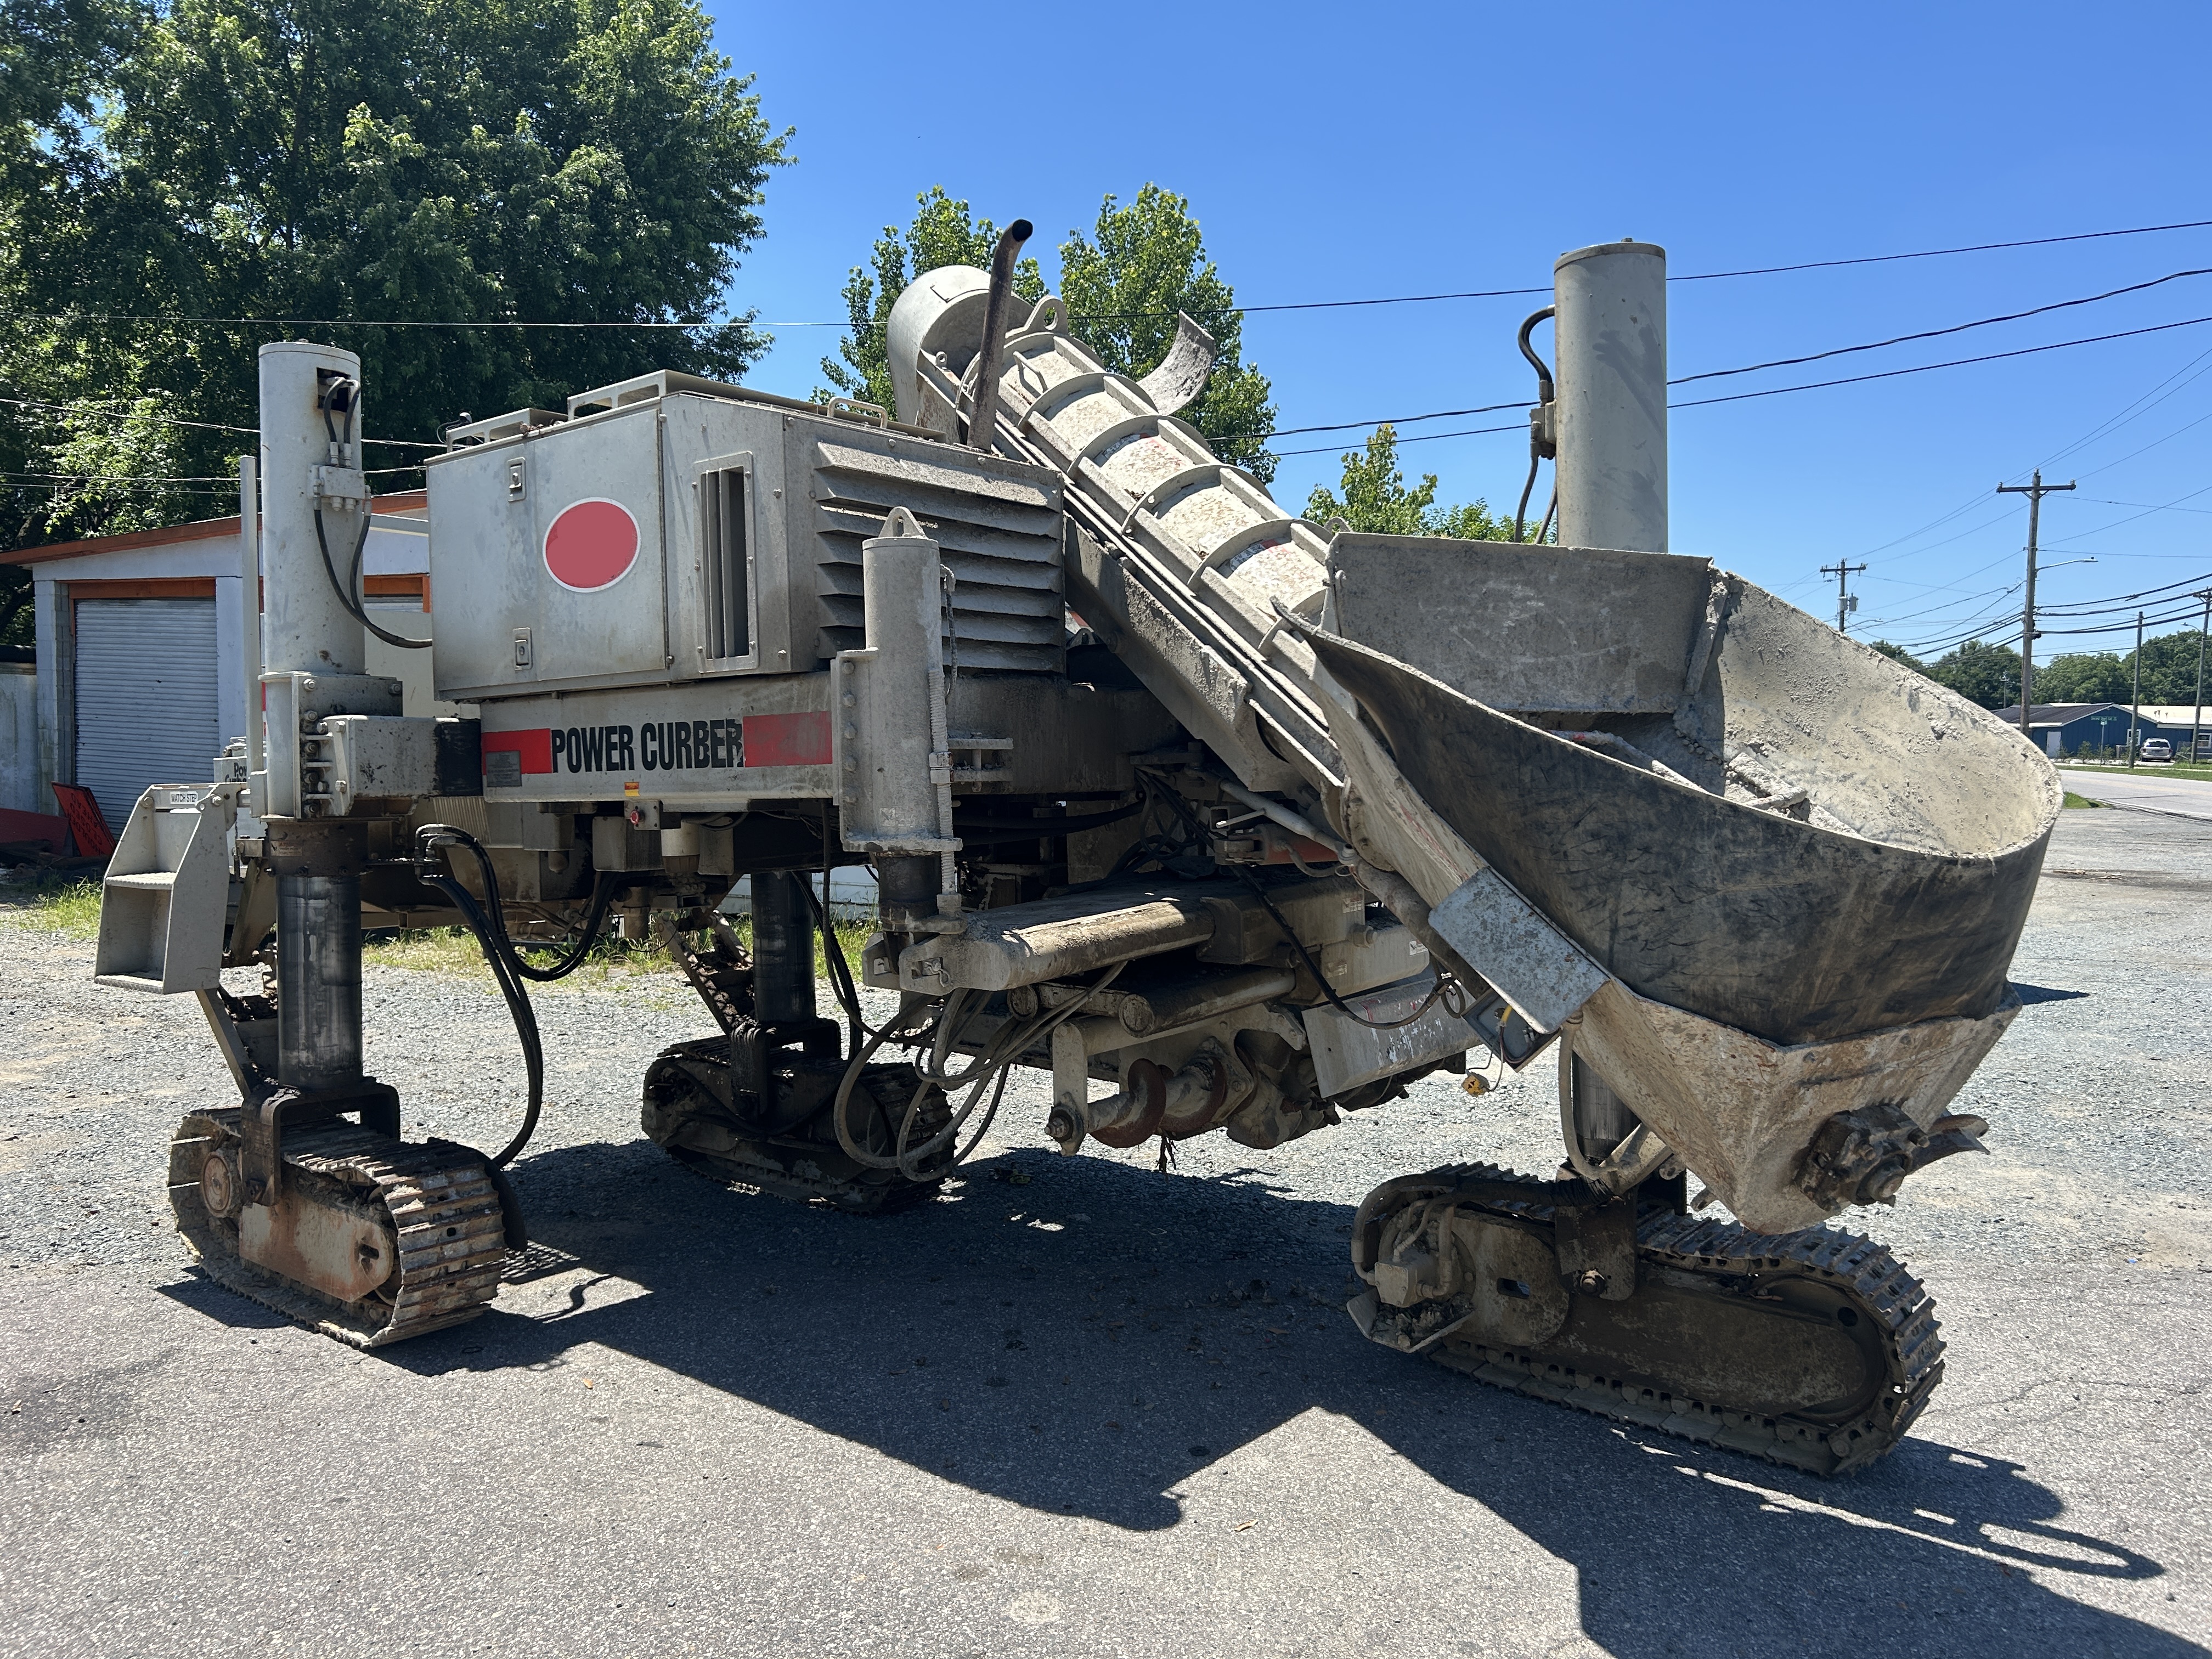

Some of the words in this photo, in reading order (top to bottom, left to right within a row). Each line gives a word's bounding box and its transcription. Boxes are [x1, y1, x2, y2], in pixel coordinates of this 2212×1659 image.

[551, 725, 635, 774] POWER
[641, 718, 744, 771] CURBER
[171, 793, 186, 803] WATCH
[187, 793, 197, 803] STEP
